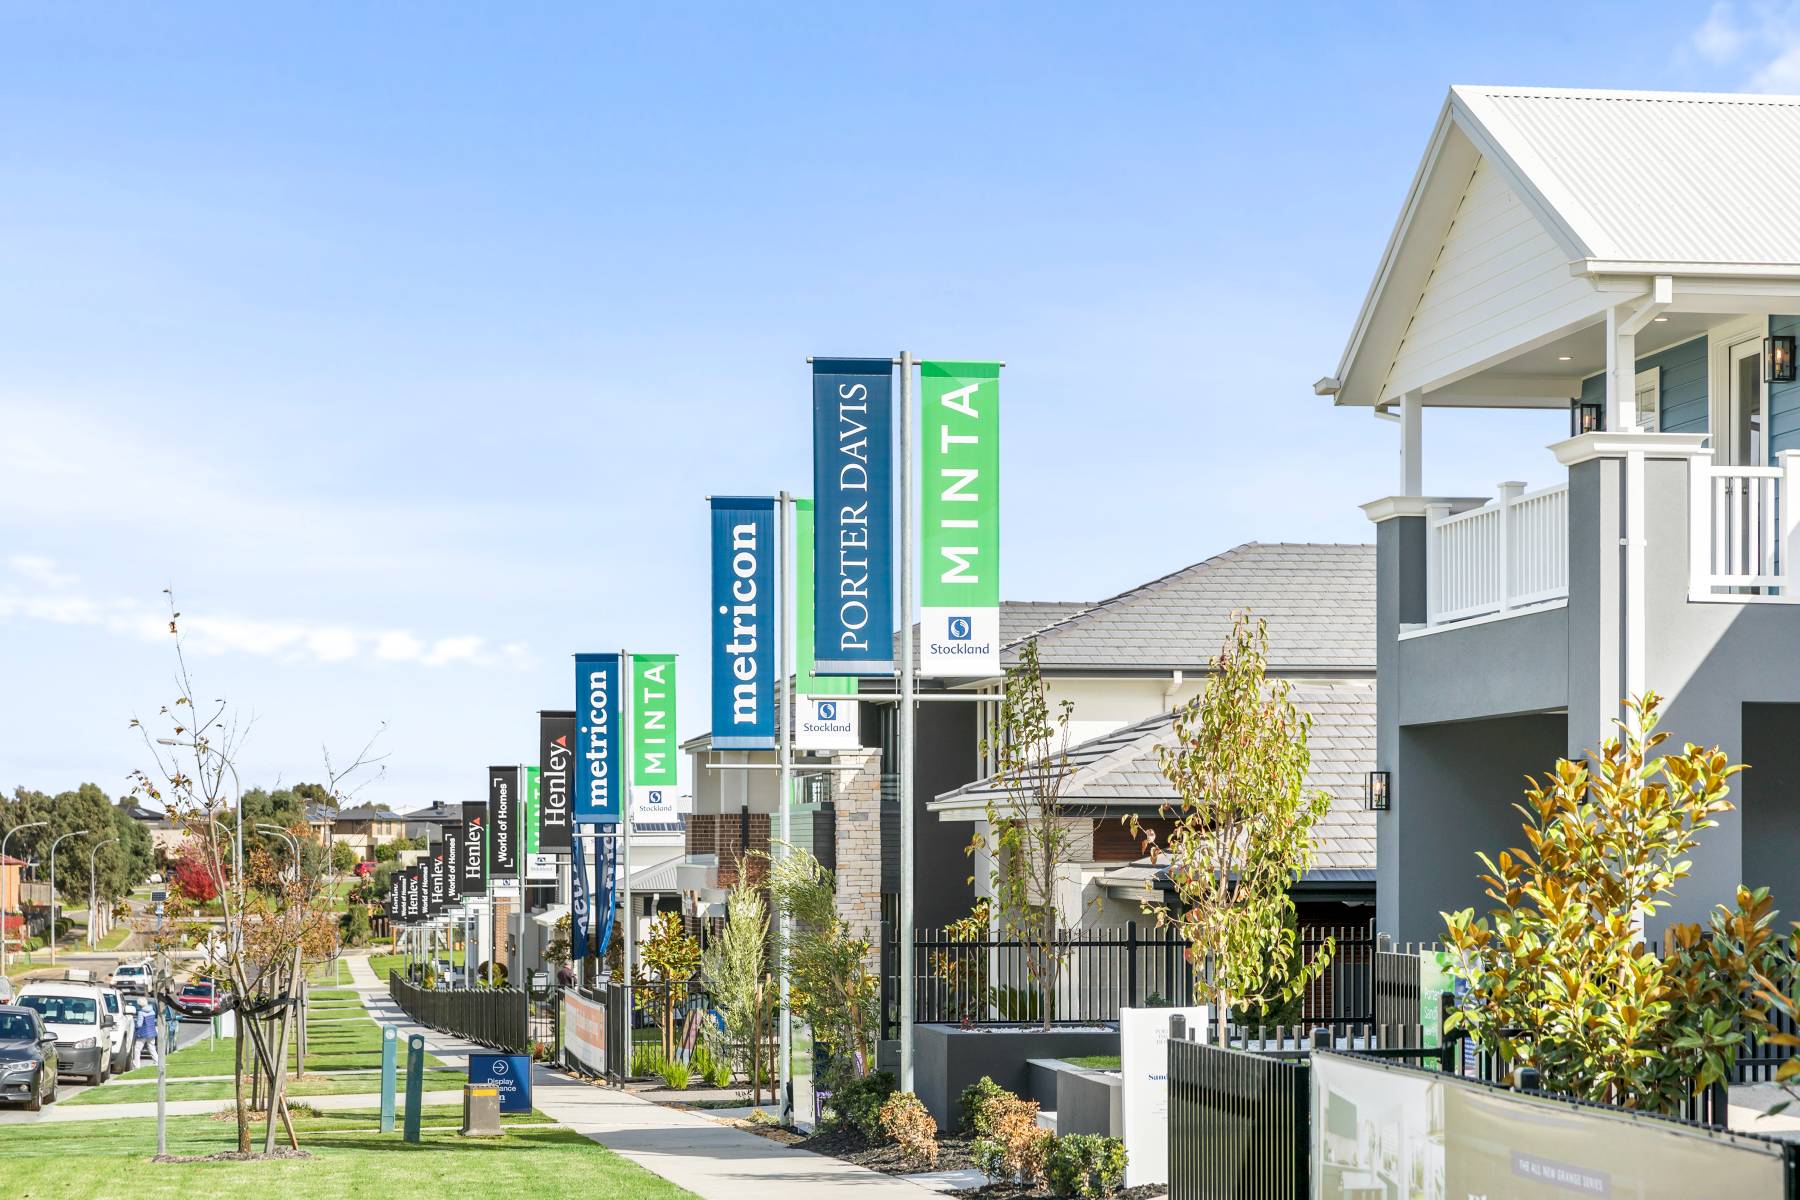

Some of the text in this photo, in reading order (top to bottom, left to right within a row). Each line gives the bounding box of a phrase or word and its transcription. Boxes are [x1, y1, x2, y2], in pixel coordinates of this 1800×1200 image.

[940, 383, 979, 584] MINTA
[839, 383, 868, 652] PORTER DAVIS
[719, 522, 758, 725] metricon
[930, 642, 990, 655] Stockland
[644, 664, 667, 774] MINTA
[803, 722, 852, 732] Stockland
[581, 670, 608, 807] metricon
[544, 742, 572, 828] Henley
[498, 783, 508, 863] World of Homes
[639, 805, 673, 813] Stockland
[465, 822, 485, 879] Henley
[431, 859, 443, 903] Henley
[448, 864, 456, 873] of
[448, 874, 456, 896] World
[408, 879, 418, 914] Henley
[422, 887, 429, 895] of
[488, 1078, 514, 1086] Display
[1148, 1073, 1168, 1081] Sand
[1519, 1159, 1604, 1192] THE ALL NEW GRANGE SERIES
